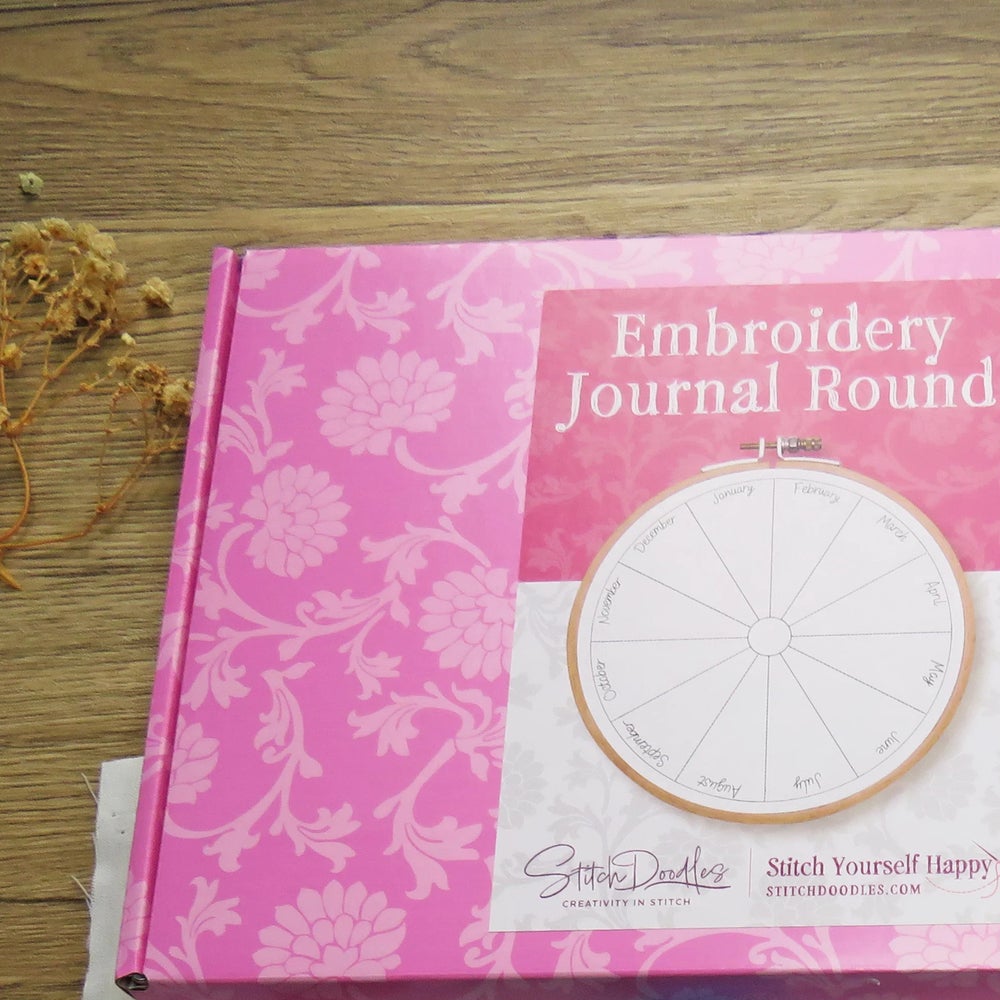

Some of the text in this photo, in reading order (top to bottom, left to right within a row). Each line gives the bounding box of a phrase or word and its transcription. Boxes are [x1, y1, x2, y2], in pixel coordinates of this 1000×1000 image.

[611, 301, 955, 366] Embroidery
[555, 356, 997, 433] Journal Round
[713, 484, 755, 504] January
[793, 482, 841, 504] February
[634, 515, 676, 554] December
[876, 514, 908, 542] March
[599, 577, 622, 625] November
[927, 581, 947, 606] April
[597, 659, 617, 702] October
[923, 659, 944, 687] May
[622, 720, 669, 768] September
[876, 731, 900, 755] June
[697, 774, 742, 799] August
[793, 773, 823, 794] July
[524, 844, 731, 898] StitchDoodles
[766, 853, 993, 880] Stitch Yourself Happy
[562, 898, 690, 908] CREATIVITY IN STITCH
[766, 884, 922, 896] STITCHDOODLES.COM
